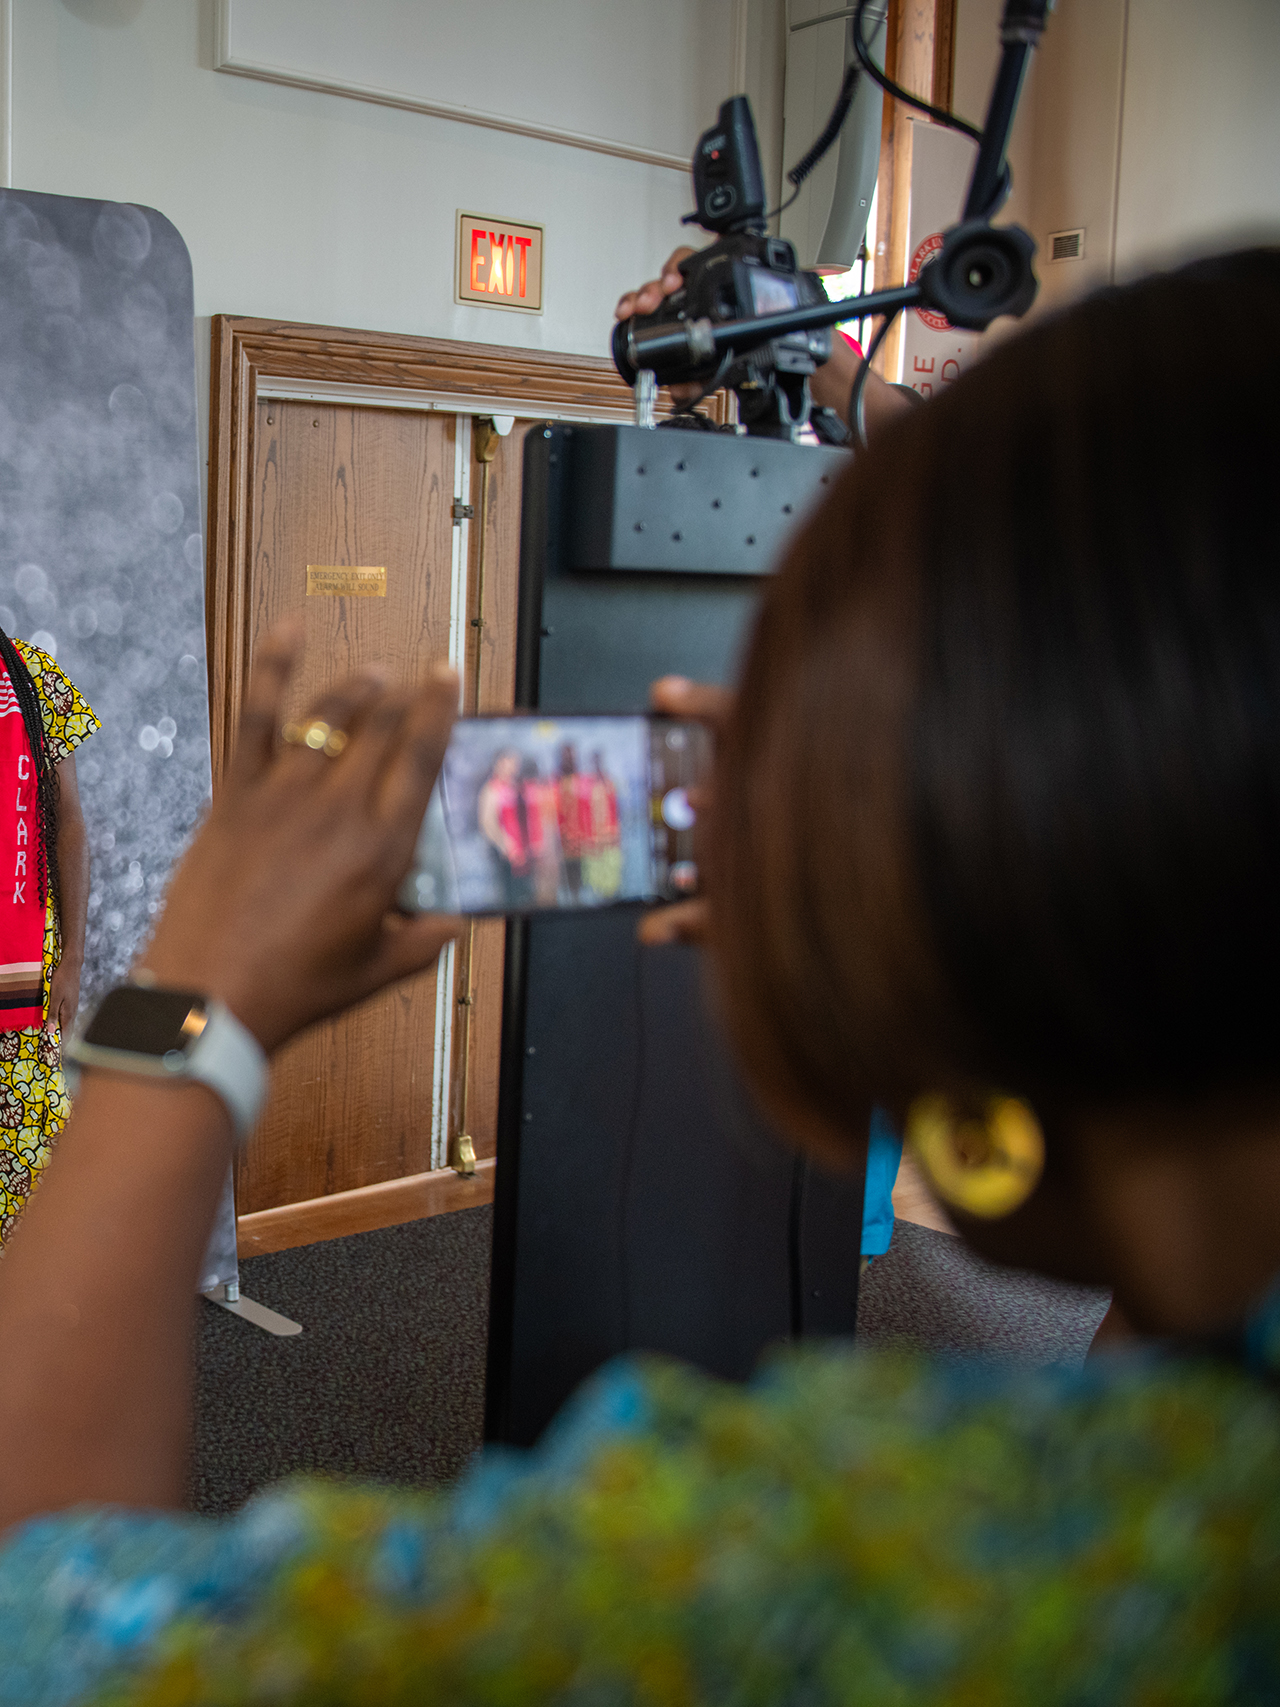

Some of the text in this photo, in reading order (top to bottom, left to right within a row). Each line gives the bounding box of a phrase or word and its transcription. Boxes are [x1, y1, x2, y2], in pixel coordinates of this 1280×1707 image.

[470, 229, 532, 298] EXIT
[310, 571, 384, 581] EMERGENCY EXIT ONLY
[340, 582, 356, 591] WILL
[358, 583, 380, 591] SOUND
[12, 754, 30, 905] CLARK
